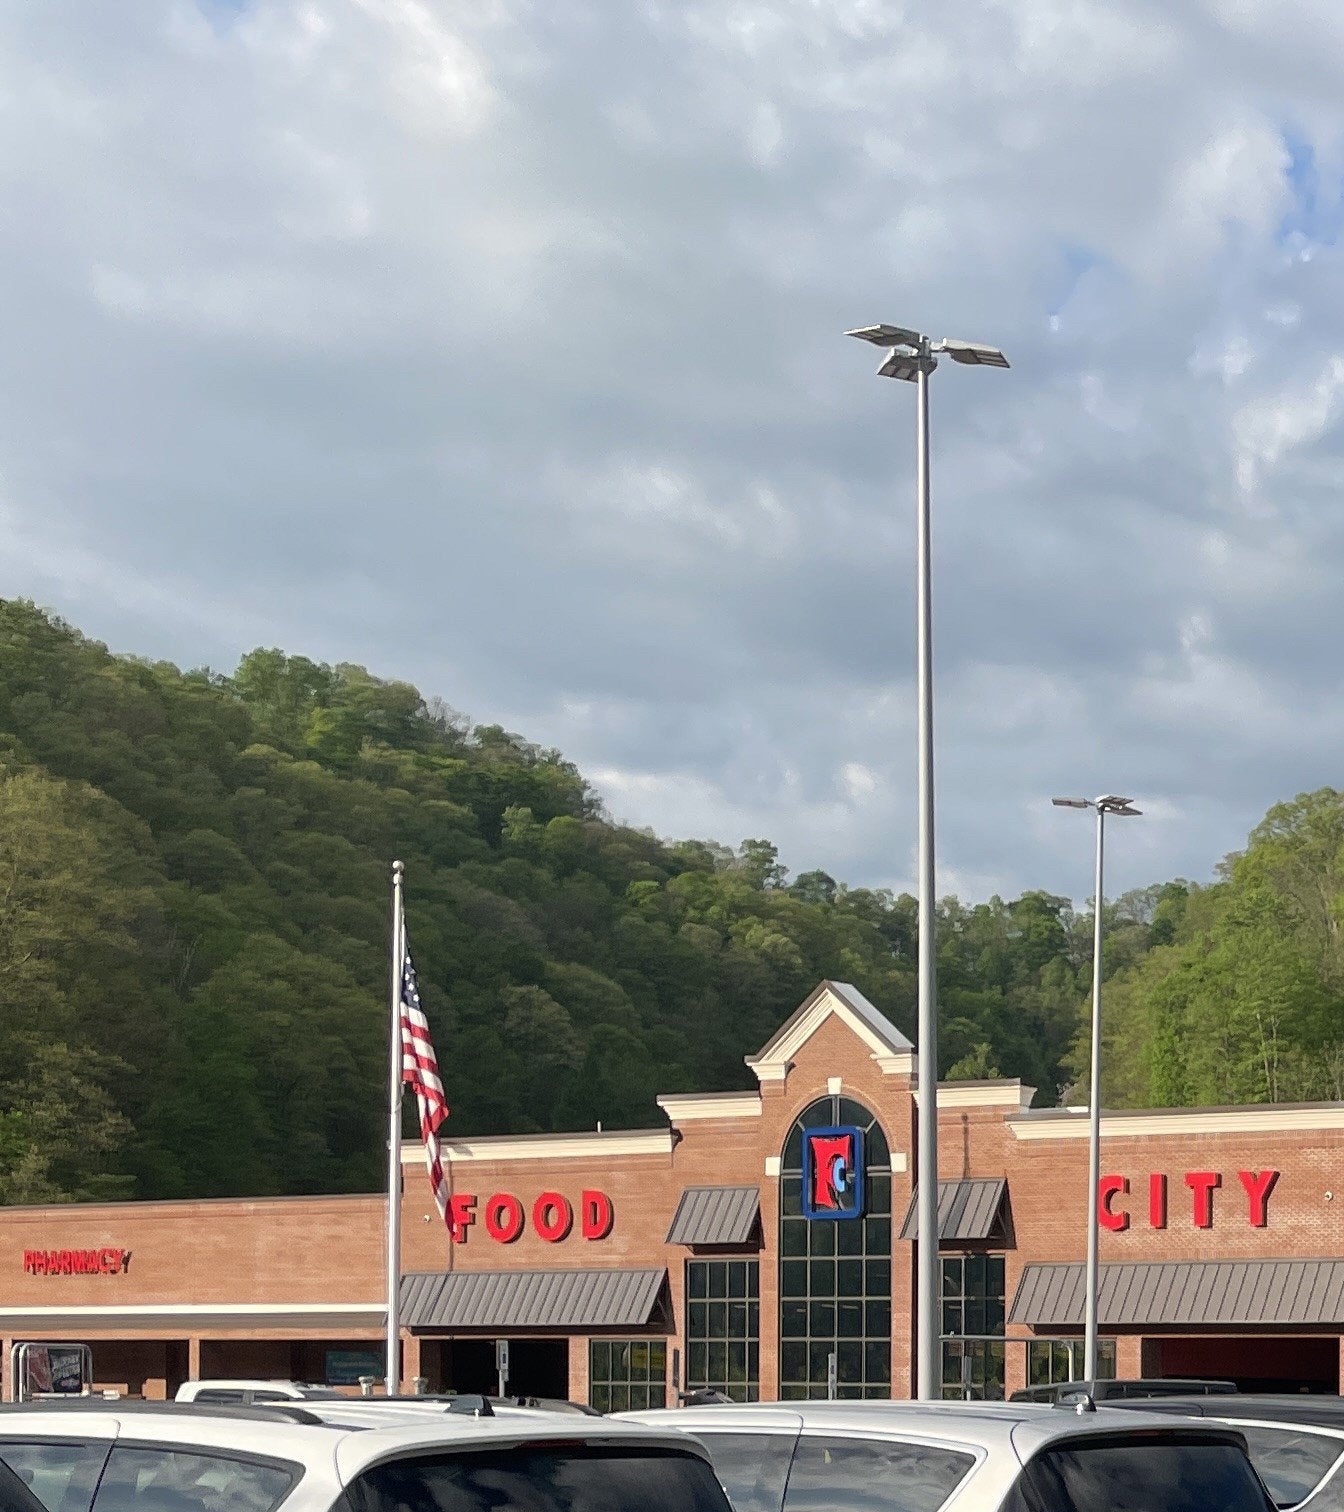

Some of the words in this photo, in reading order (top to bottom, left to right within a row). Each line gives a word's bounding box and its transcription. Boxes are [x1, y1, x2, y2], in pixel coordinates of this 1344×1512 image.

[450, 1190, 614, 1244] FOOD
[1098, 1171, 1280, 1231] CITY
[23, 1247, 131, 1275] PHARMACY
